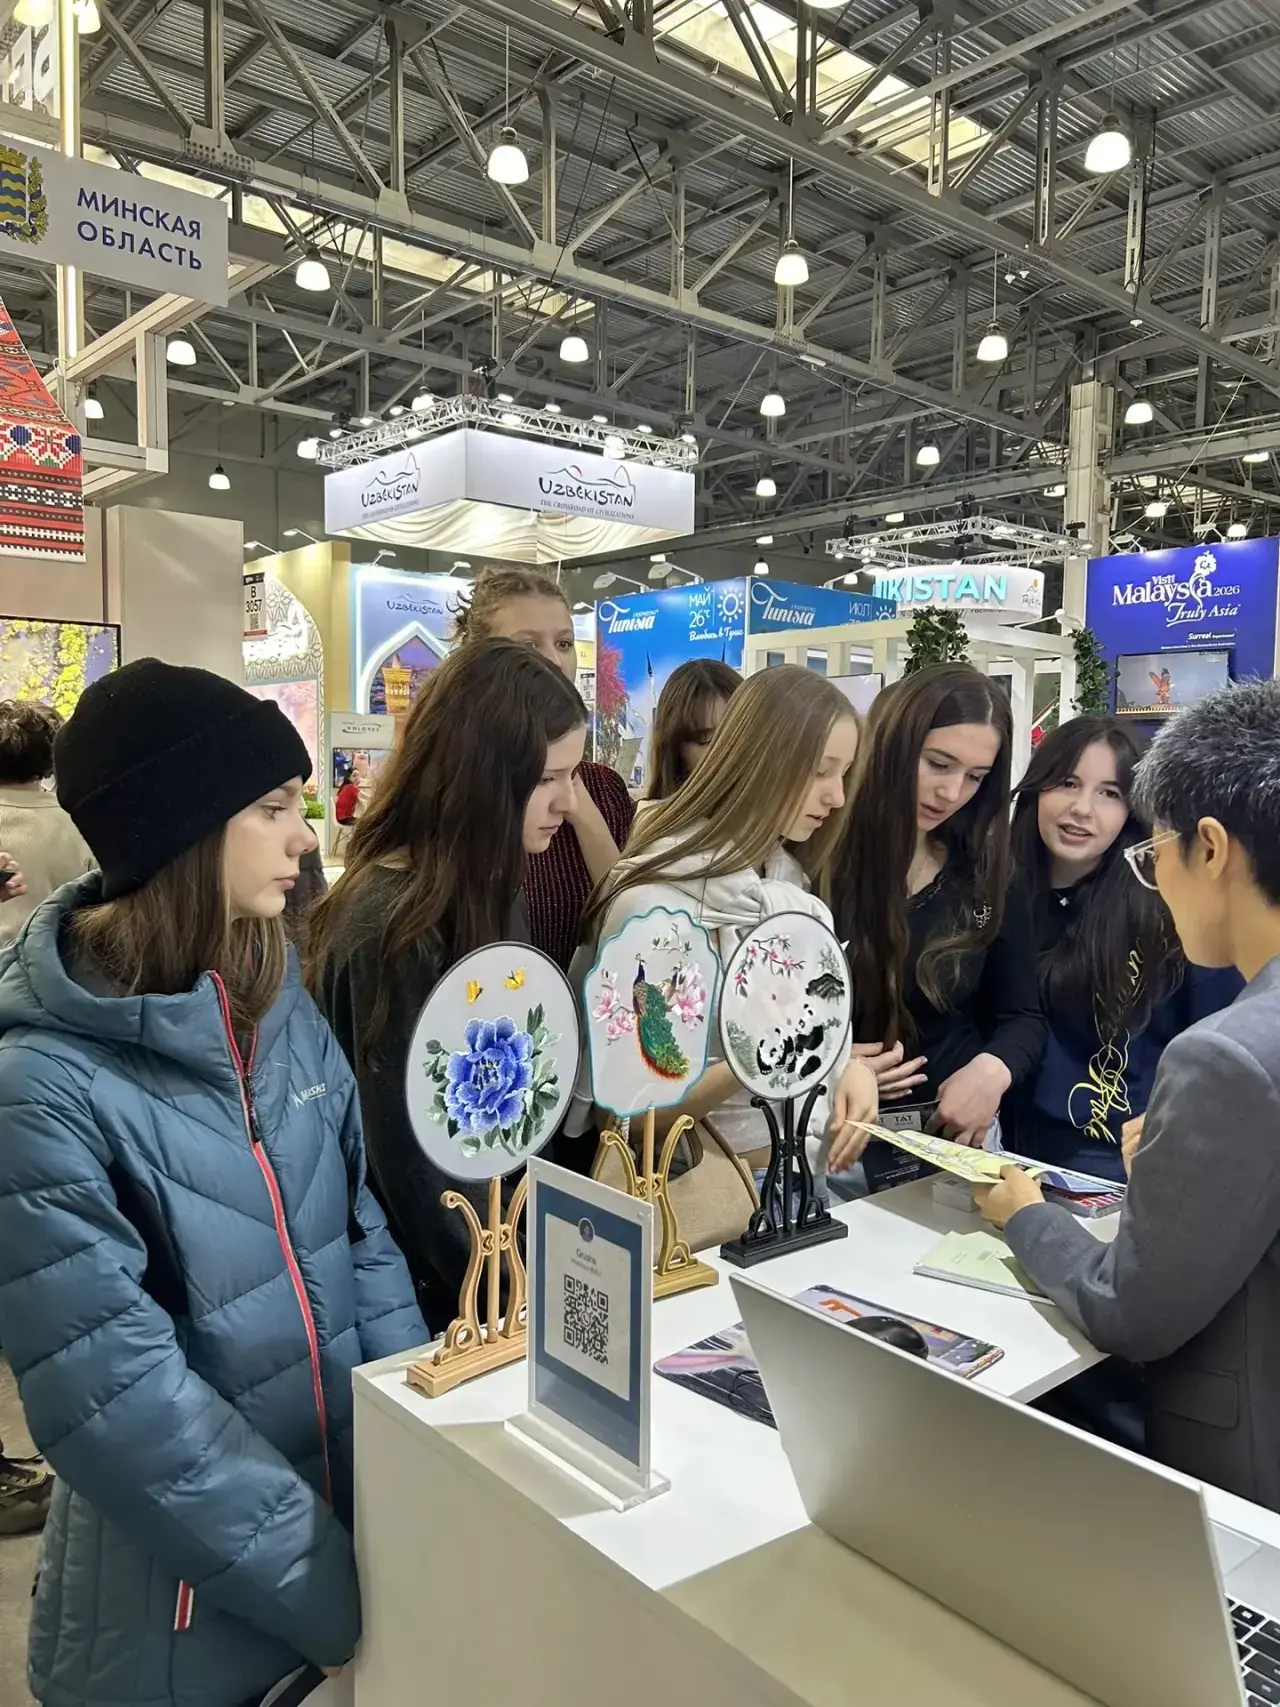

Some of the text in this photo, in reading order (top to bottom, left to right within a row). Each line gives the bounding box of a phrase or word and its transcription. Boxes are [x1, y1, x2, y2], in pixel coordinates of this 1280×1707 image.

[77, 187, 201, 240] МИНСКАЯ
[77, 220, 202, 270] ОБЛАСТЬ
[361, 483, 417, 507] UZBEKISTAN
[538, 476, 633, 507] UZBEKISTAN
[689, 586, 711, 608] МАЙ
[752, 582, 816, 626] Tunisia
[1112, 573, 1240, 606] Malaysia 2026
[386, 600, 444, 615] UZBEKISTAN
[599, 600, 656, 634] Tunisia
[1166, 602, 1239, 622] Truly Asia
